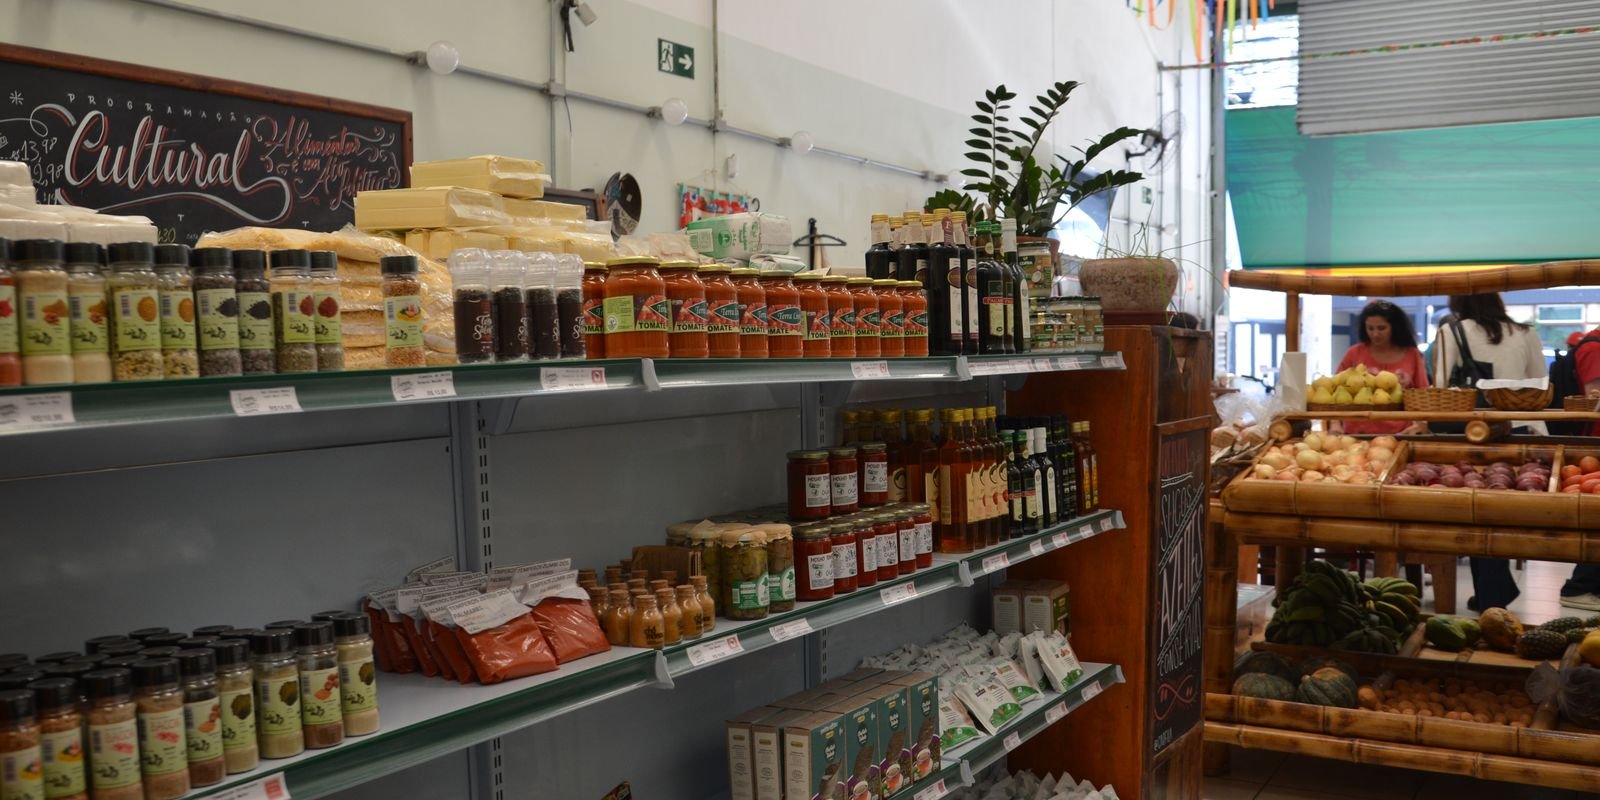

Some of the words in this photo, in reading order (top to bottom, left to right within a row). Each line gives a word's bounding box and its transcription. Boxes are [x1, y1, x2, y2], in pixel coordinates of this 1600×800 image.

[68, 93, 251, 124] PROGRAMAÇÃO
[65, 110, 252, 192] Cultural
[1160, 484, 1193, 552] SUCOS
[1160, 503, 1204, 647] AZEITES
